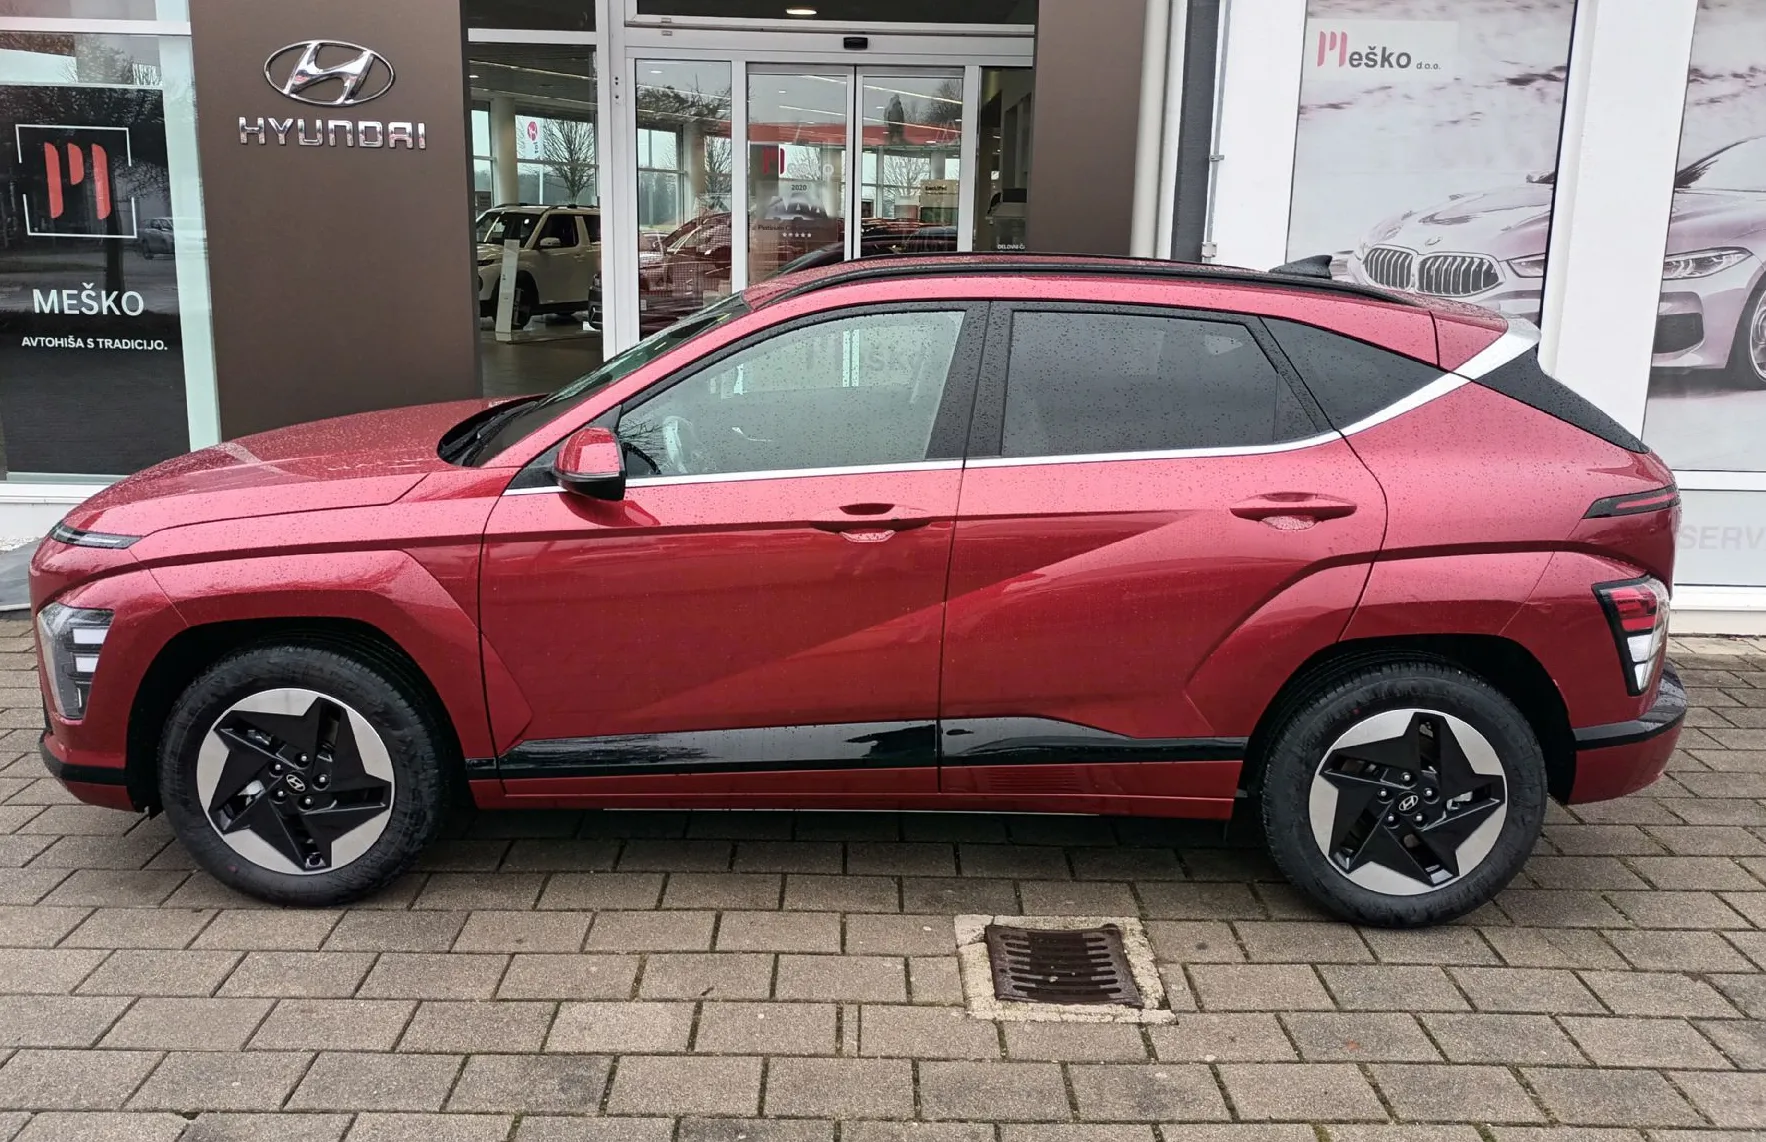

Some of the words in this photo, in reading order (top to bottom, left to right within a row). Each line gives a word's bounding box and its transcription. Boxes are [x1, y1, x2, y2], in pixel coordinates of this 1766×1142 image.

[239, 117, 426, 149] HYUNDAI
[32, 282, 144, 316] MEŠKO
[21, 335, 85, 348] AVTOHIŠA
[87, 339, 95, 348] S
[96, 338, 168, 350] TRADICIJO.
